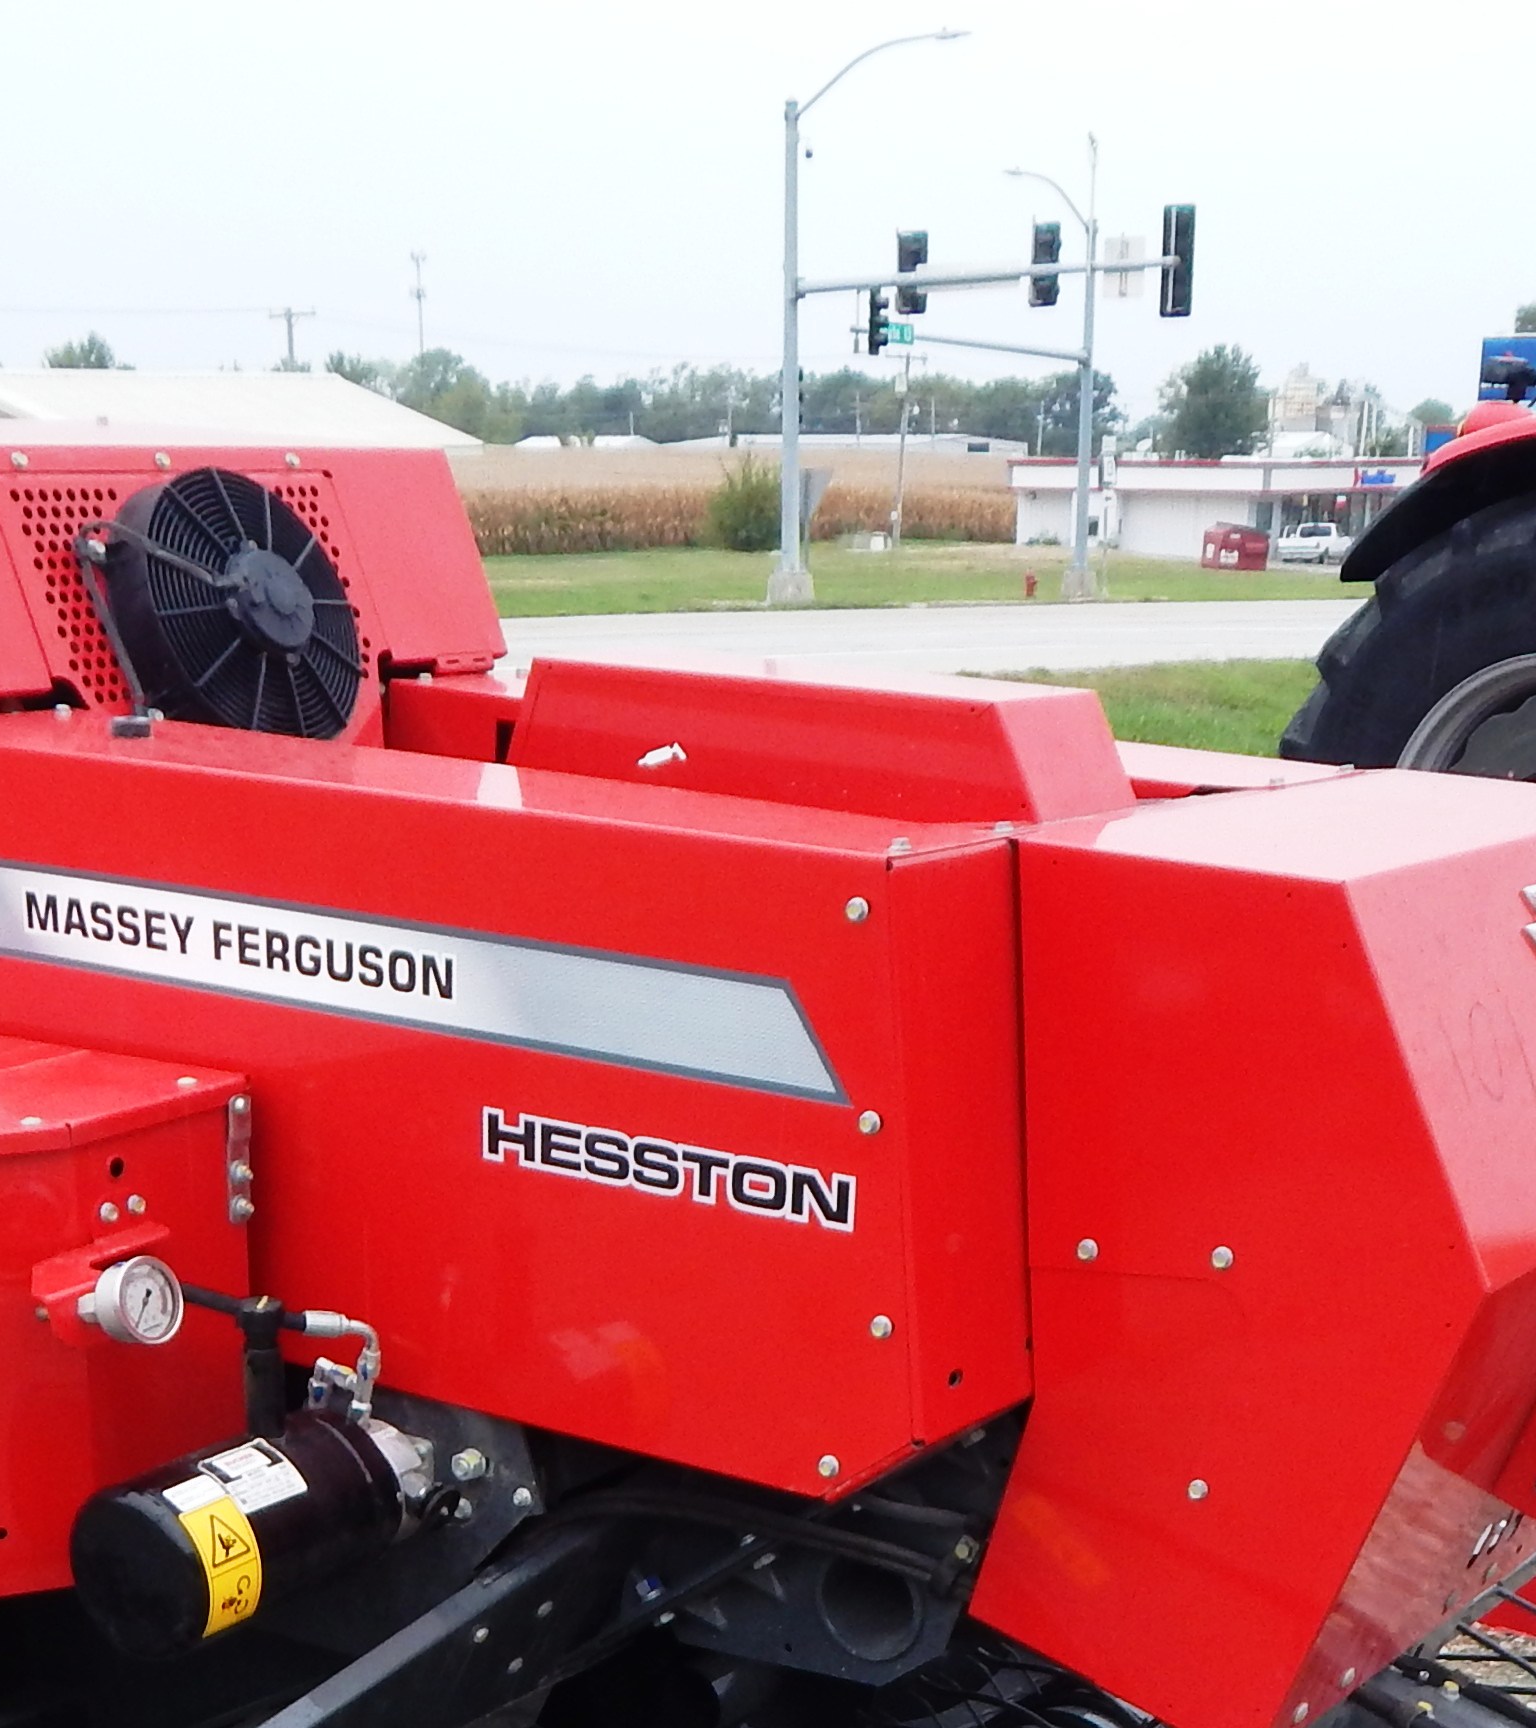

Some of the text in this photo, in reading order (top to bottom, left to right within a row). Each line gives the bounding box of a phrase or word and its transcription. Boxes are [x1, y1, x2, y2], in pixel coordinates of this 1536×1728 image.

[25, 889, 194, 955] MASSEY
[212, 918, 455, 1000] FERGUSON
[485, 1109, 852, 1229] HESSTON
